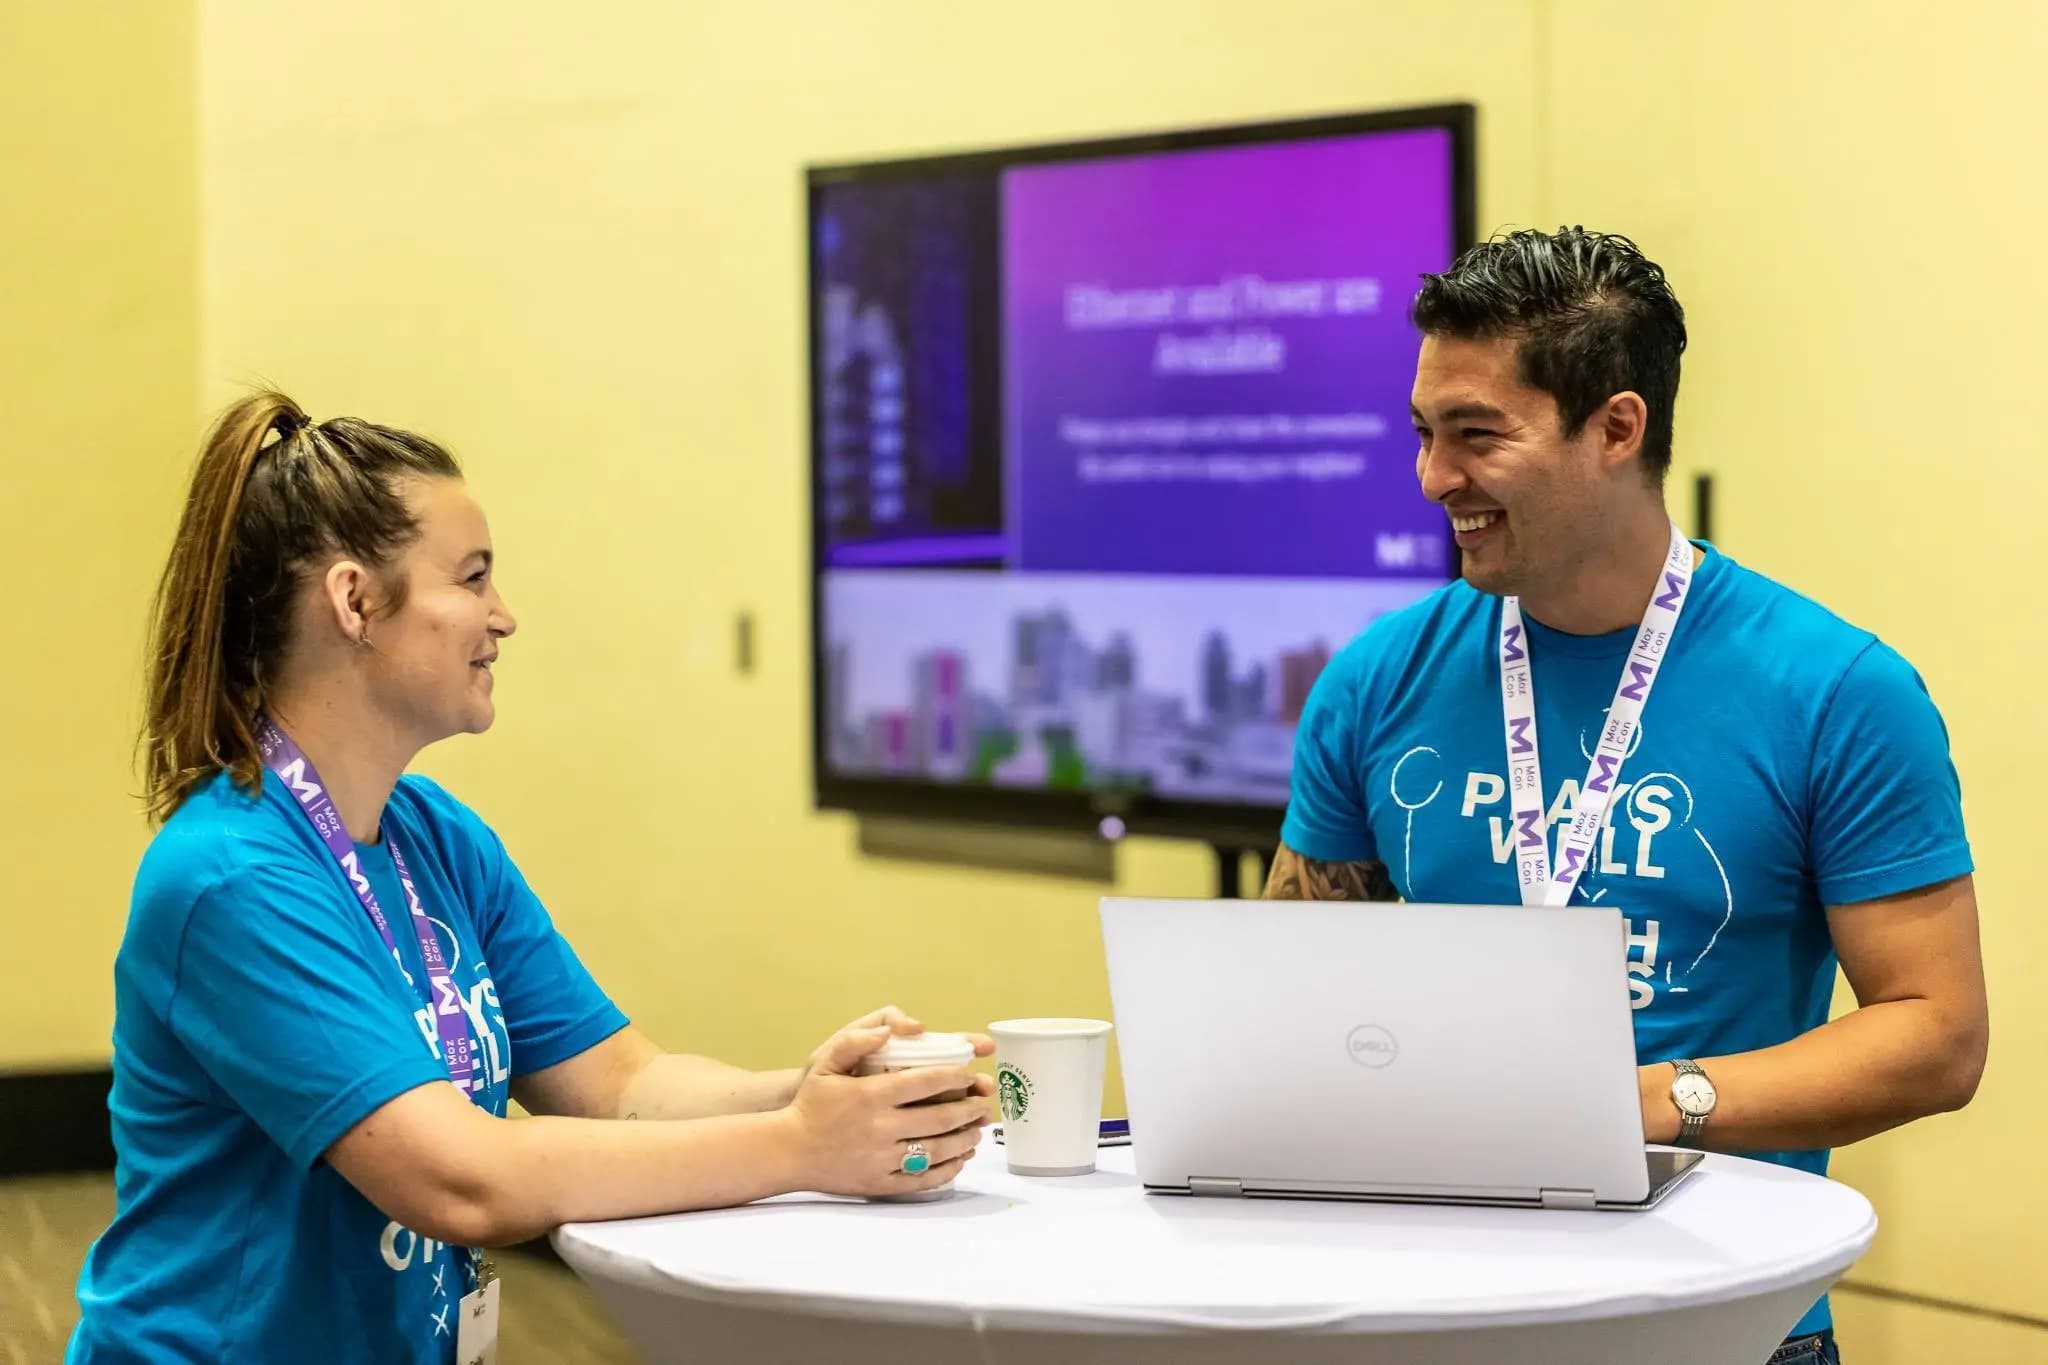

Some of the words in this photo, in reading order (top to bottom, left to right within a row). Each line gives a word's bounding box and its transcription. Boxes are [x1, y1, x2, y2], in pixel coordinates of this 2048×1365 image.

[1654, 571, 1686, 612] M
[1503, 624, 1525, 663] M
[1638, 627, 1654, 651] Moz
[1651, 631, 1666, 654] Con
[1506, 675, 1515, 698] Con
[1517, 672, 1528, 695] Moz
[1620, 661, 1653, 702] M
[1509, 716, 1533, 754] M
[1605, 719, 1620, 742] Moz
[1617, 721, 1631, 744] Con
[281, 757, 322, 803] M
[1514, 767, 1524, 790] Con
[1526, 765, 1535, 788] Moz
[1588, 754, 1619, 793] M
[1461, 771, 1674, 834] PAYS
[314, 813, 332, 838] Con
[323, 806, 341, 832] Moz
[1517, 809, 1543, 847] M
[1574, 811, 1588, 835] Moz
[1585, 814, 1598, 837] Con
[341, 850, 370, 895] M
[1522, 861, 1532, 885] Con
[1535, 859, 1545, 883] Moz
[1555, 847, 1586, 884] M
[421, 938, 434, 962] Moz
[430, 938, 442, 962] Con
[431, 975, 460, 1016] M
[445, 1039, 457, 1066] Moz
[457, 1037, 469, 1064] Con
